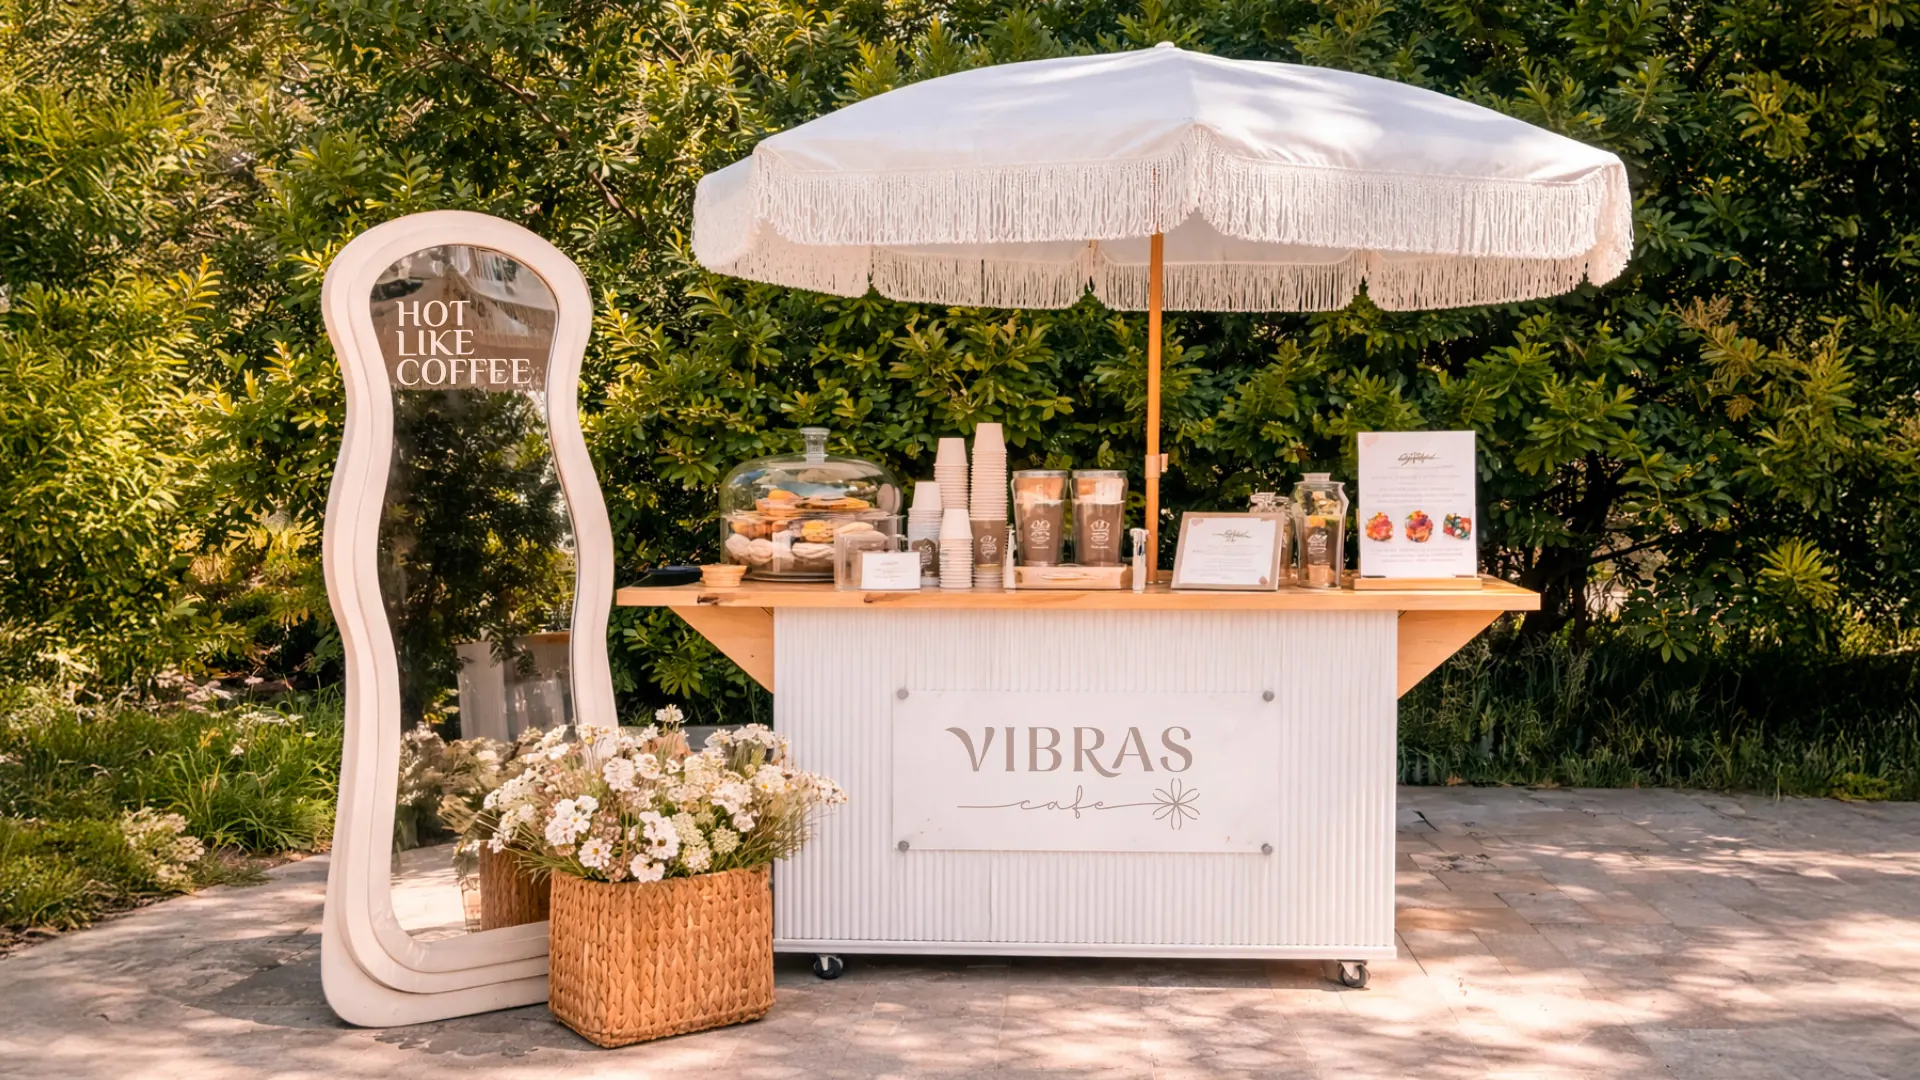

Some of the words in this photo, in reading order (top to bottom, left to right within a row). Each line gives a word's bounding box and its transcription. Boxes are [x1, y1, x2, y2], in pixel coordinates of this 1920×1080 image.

[396, 300, 471, 327] HOT
[396, 329, 475, 356] LIKE
[396, 358, 532, 386] COFFEE
[945, 726, 1193, 778] VIBRAS
[1000, 785, 1113, 819] cafe
